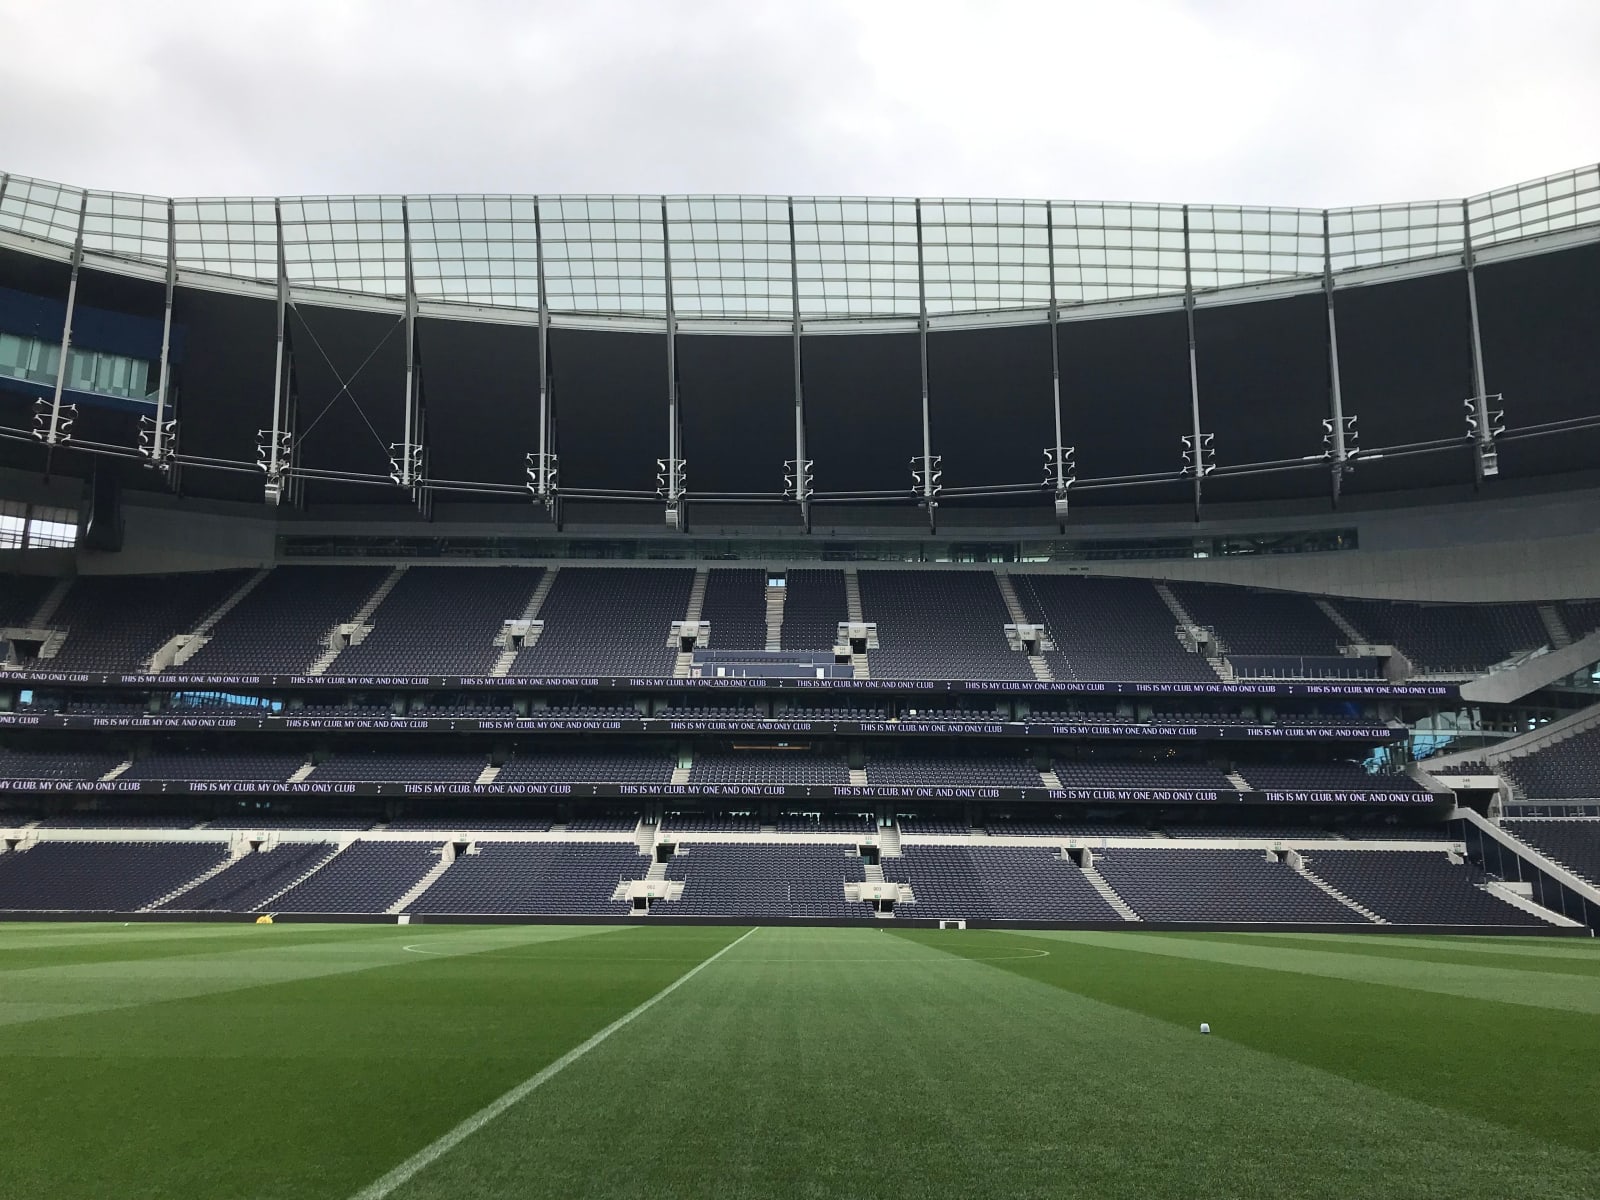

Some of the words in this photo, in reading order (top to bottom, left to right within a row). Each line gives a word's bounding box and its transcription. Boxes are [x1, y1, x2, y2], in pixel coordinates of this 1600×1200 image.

[56, 782, 73, 790] ONE
[75, 782, 94, 790] AND
[96, 782, 117, 790] ONLY
[119, 782, 140, 790] CLUB
[189, 782, 207, 791] THIS
[209, 782, 217, 791] IS
[218, 782, 232, 791] MY
[257, 783, 271, 792] MY
[272, 783, 289, 792] ONE
[291, 783, 310, 792] AND
[311, 783, 332, 792] ONLY
[334, 783, 355, 792] CLUB
[404, 784, 422, 793] THIS
[424, 784, 432, 793] IS
[433, 784, 446, 793] MY
[472, 784, 486, 793] MY
[487, 785, 504, 793] ONE
[507, 785, 525, 793] AND
[527, 785, 548, 793] ONLY
[549, 785, 571, 793] CLUB
[619, 785, 638, 794] THIS
[639, 785, 647, 794] IS
[649, 785, 662, 794] MY
[688, 785, 700, 794] MY
[702, 785, 719, 794] ONE
[721, 786, 739, 794] AND
[741, 786, 762, 795] ONLY
[764, 786, 784, 795] CLUB
[833, 787, 851, 796] THIS
[853, 787, 860, 796] IS
[862, 787, 875, 796] MY
[901, 787, 914, 796] MY
[916, 788, 933, 796] ONE
[935, 788, 953, 797] AND
[955, 788, 976, 797] ONLY
[978, 788, 999, 797] CLUB
[1048, 790, 1066, 799] THIS
[1068, 790, 1076, 799] IS
[1078, 790, 1091, 799] MY
[1118, 791, 1131, 800] MY
[1133, 791, 1150, 800] ONE
[1152, 791, 1170, 800] AND
[1172, 791, 1193, 800] ONLY
[1195, 792, 1217, 800] CLUB
[1265, 792, 1284, 801] THIS
[1286, 792, 1294, 801] IS
[1295, 792, 1308, 801] MY
[1334, 793, 1347, 802] MY
[1349, 793, 1367, 802] ONE
[1369, 793, 1387, 802] AND
[1388, 793, 1409, 802] ONLY
[1412, 793, 1434, 802] CLUB
